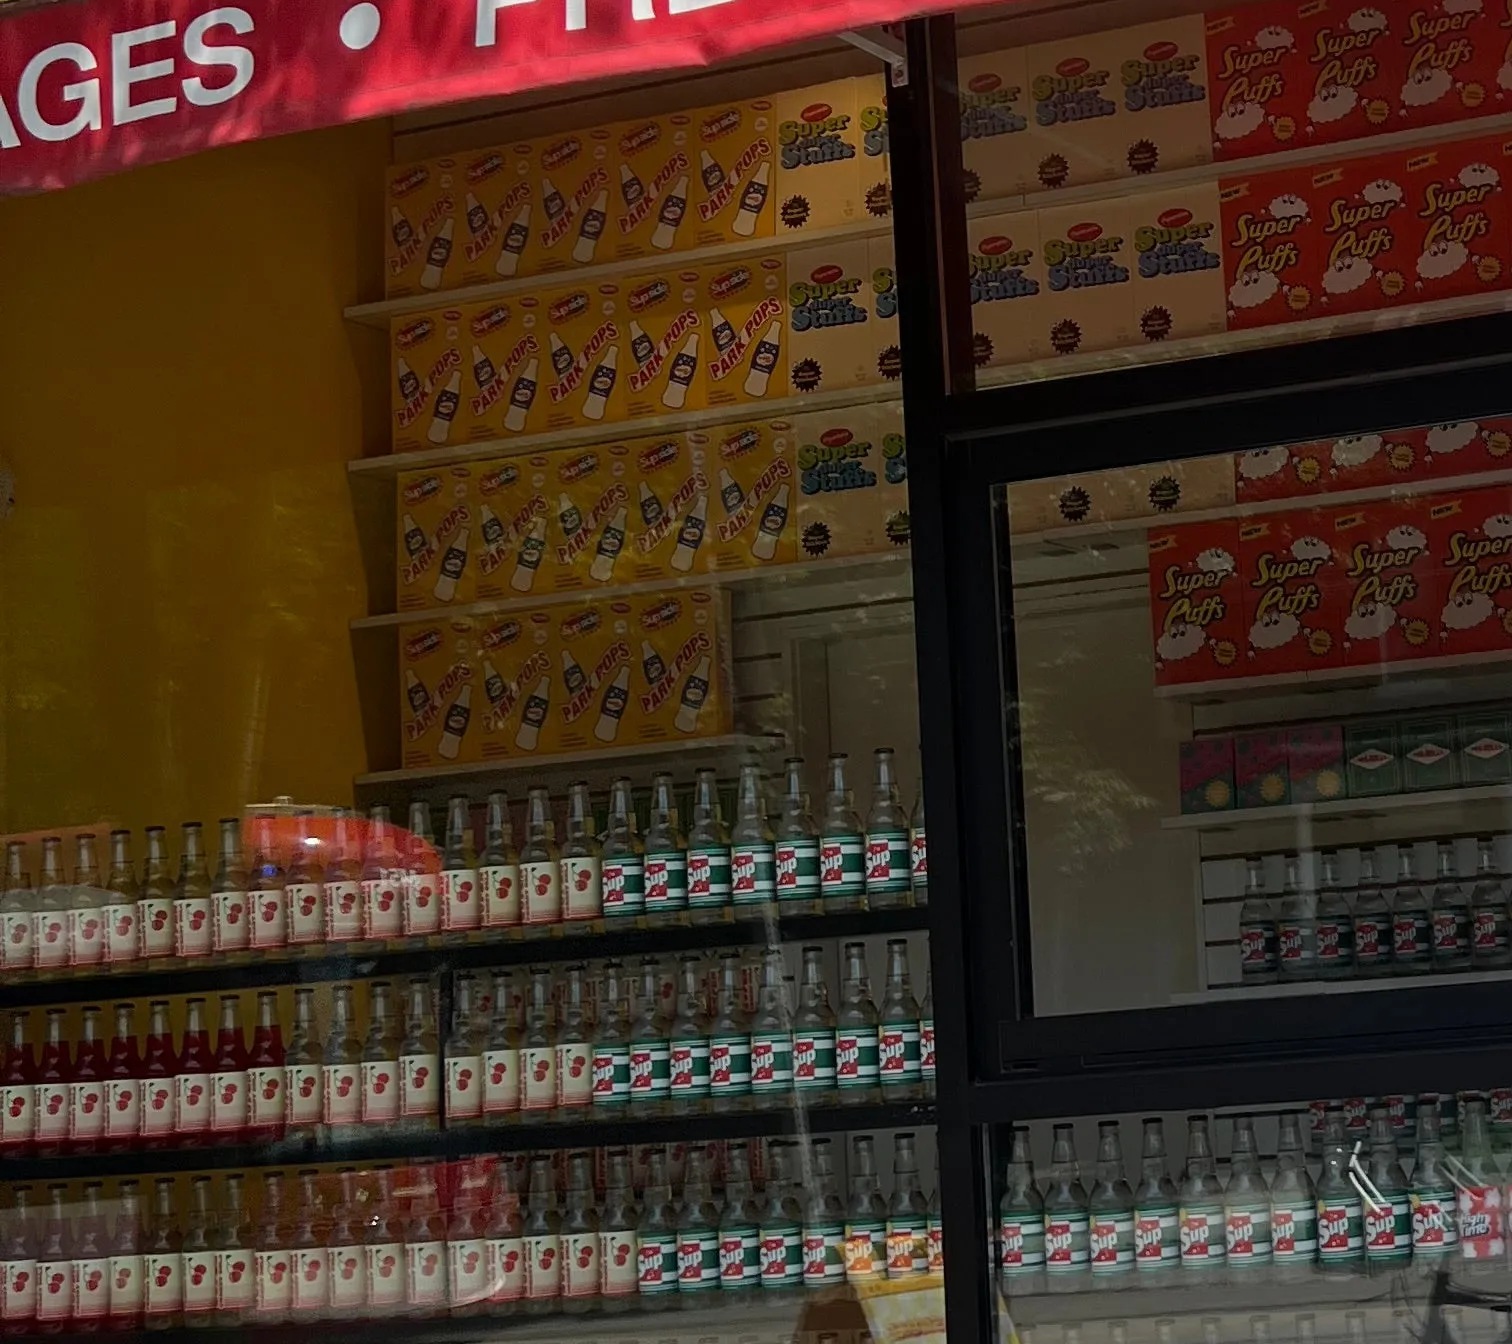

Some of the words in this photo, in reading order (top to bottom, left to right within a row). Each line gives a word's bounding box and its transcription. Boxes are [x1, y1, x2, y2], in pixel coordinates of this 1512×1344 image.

[0, 6, 256, 149] GES
[778, 114, 851, 144] Super
[698, 181, 735, 221] PARK
[734, 137, 772, 179] POPS
[1418, 183, 1490, 218] Super
[1134, 221, 1215, 253] Super
[1424, 213, 1489, 249] Puffs
[628, 353, 663, 392] PARK
[662, 309, 700, 350] POPS
[709, 340, 747, 380] PARK
[745, 297, 782, 338] POPS
[549, 364, 584, 402] PARK
[583, 321, 620, 363] POPS
[1348, 544, 1419, 577] Super
[1160, 565, 1226, 598] Super
[1352, 575, 1418, 610] Puffs
[1163, 595, 1225, 633] Puffs
[1181, 1220, 1209, 1251] Sup
[1319, 1215, 1349, 1247] Sup
[1366, 1212, 1396, 1243] Sup
